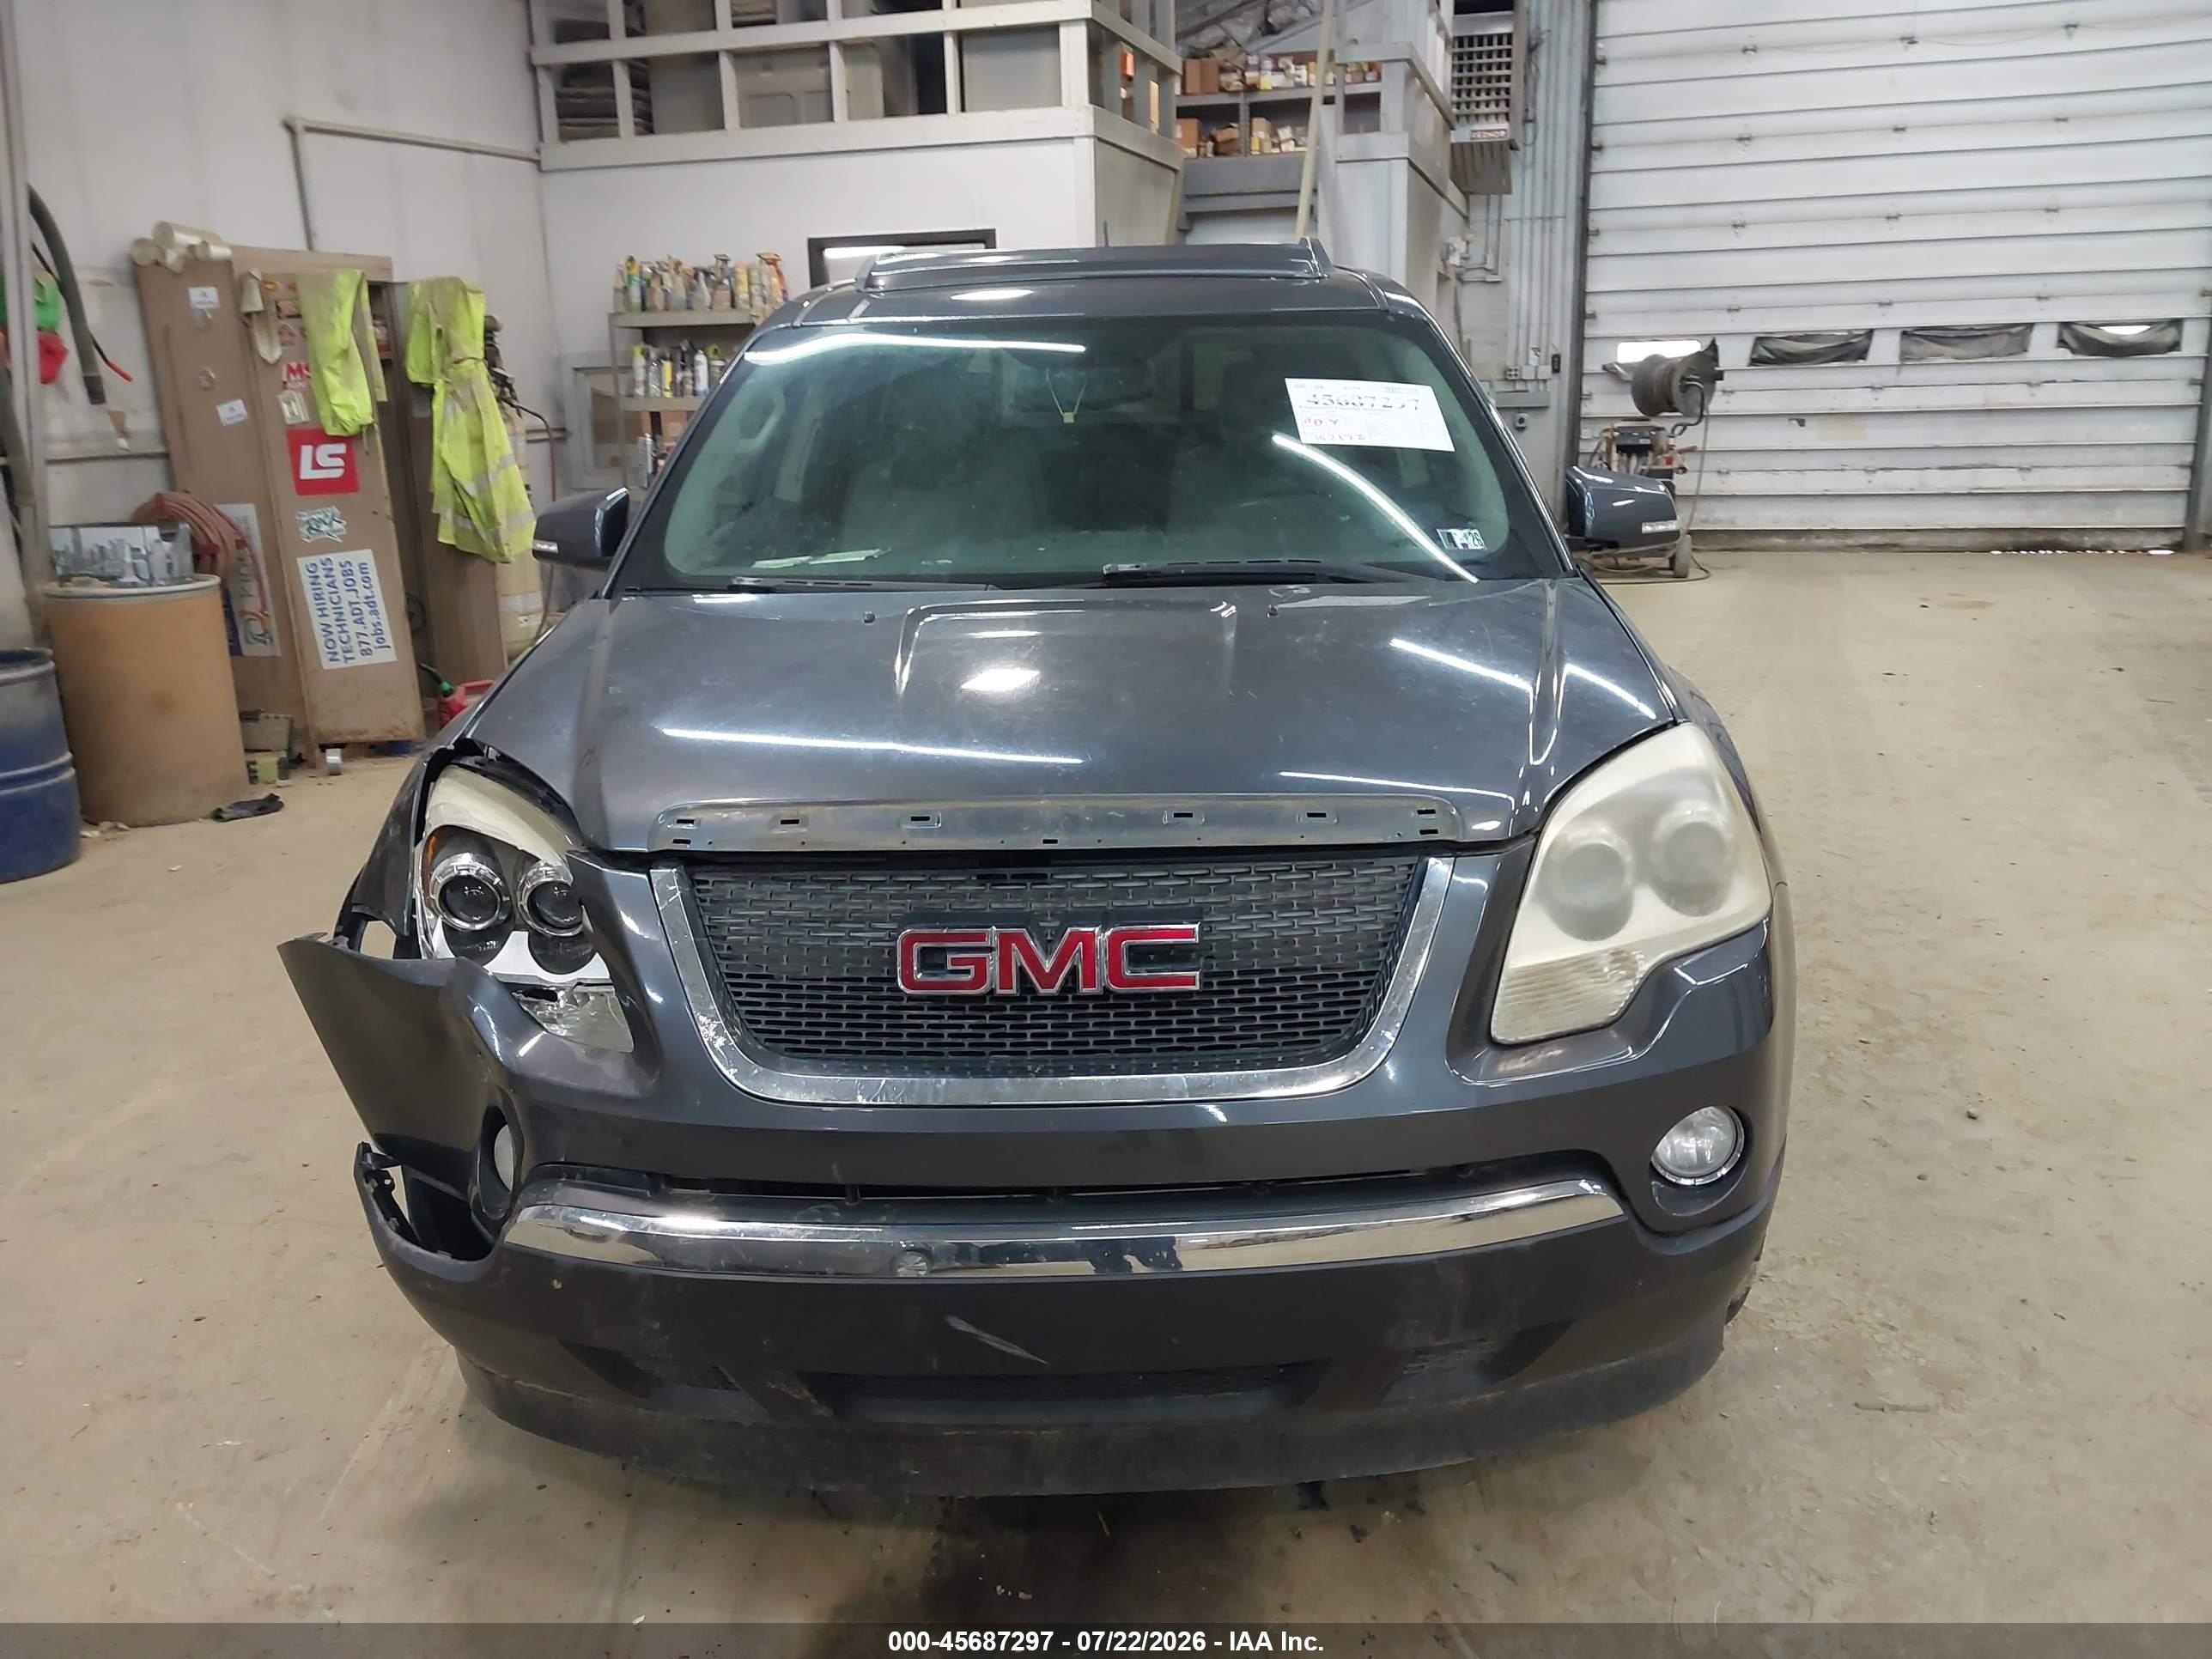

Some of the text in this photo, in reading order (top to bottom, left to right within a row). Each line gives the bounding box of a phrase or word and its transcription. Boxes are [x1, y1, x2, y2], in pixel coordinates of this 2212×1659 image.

[299, 442, 347, 480] LS
[305, 562, 330, 617] HIRING
[320, 556, 356, 664] TECHNICIANS
[339, 560, 373, 657] 877.ADT.JOBS
[357, 562, 392, 649] jobs.adt.com
[319, 623, 340, 662] NOW
[897, 921, 1201, 995] GMC
